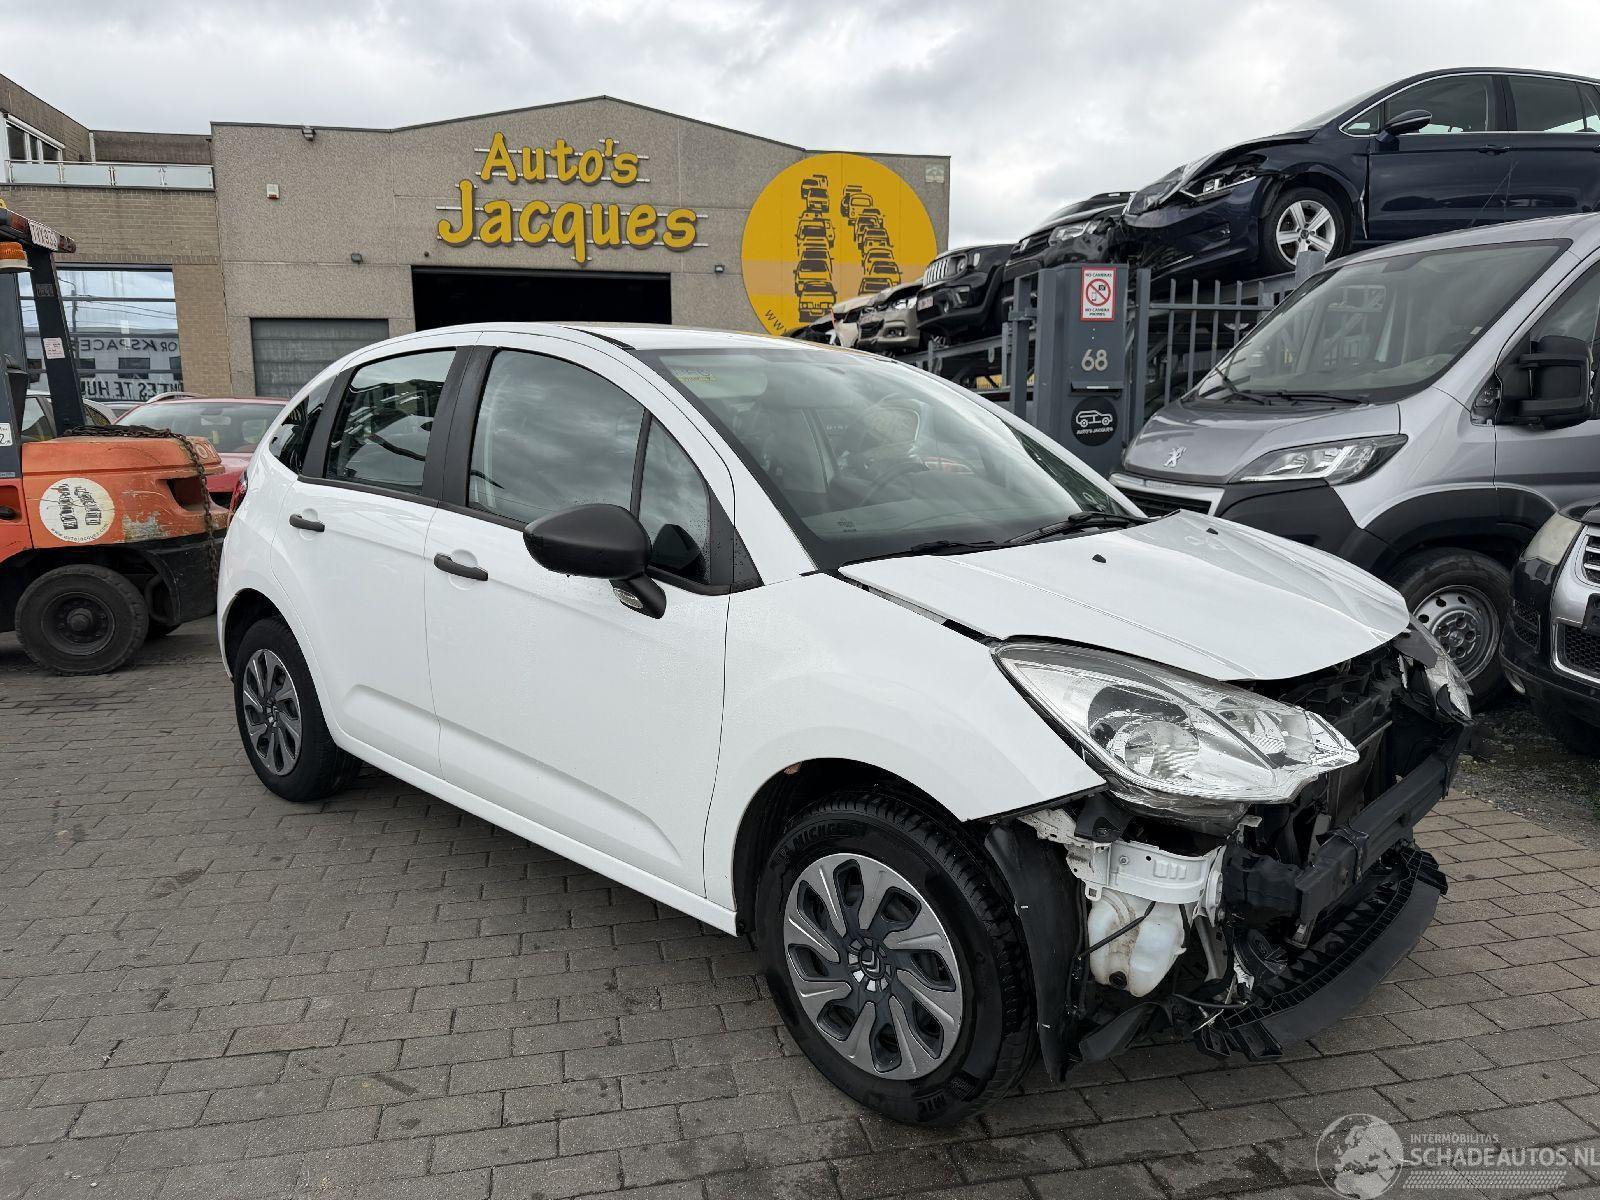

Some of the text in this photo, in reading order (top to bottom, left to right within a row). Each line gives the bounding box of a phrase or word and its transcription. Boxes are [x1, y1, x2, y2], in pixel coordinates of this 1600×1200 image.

[480, 131, 639, 187] Auto's
[437, 179, 698, 263] Jacques
[1081, 349, 1108, 371] 68
